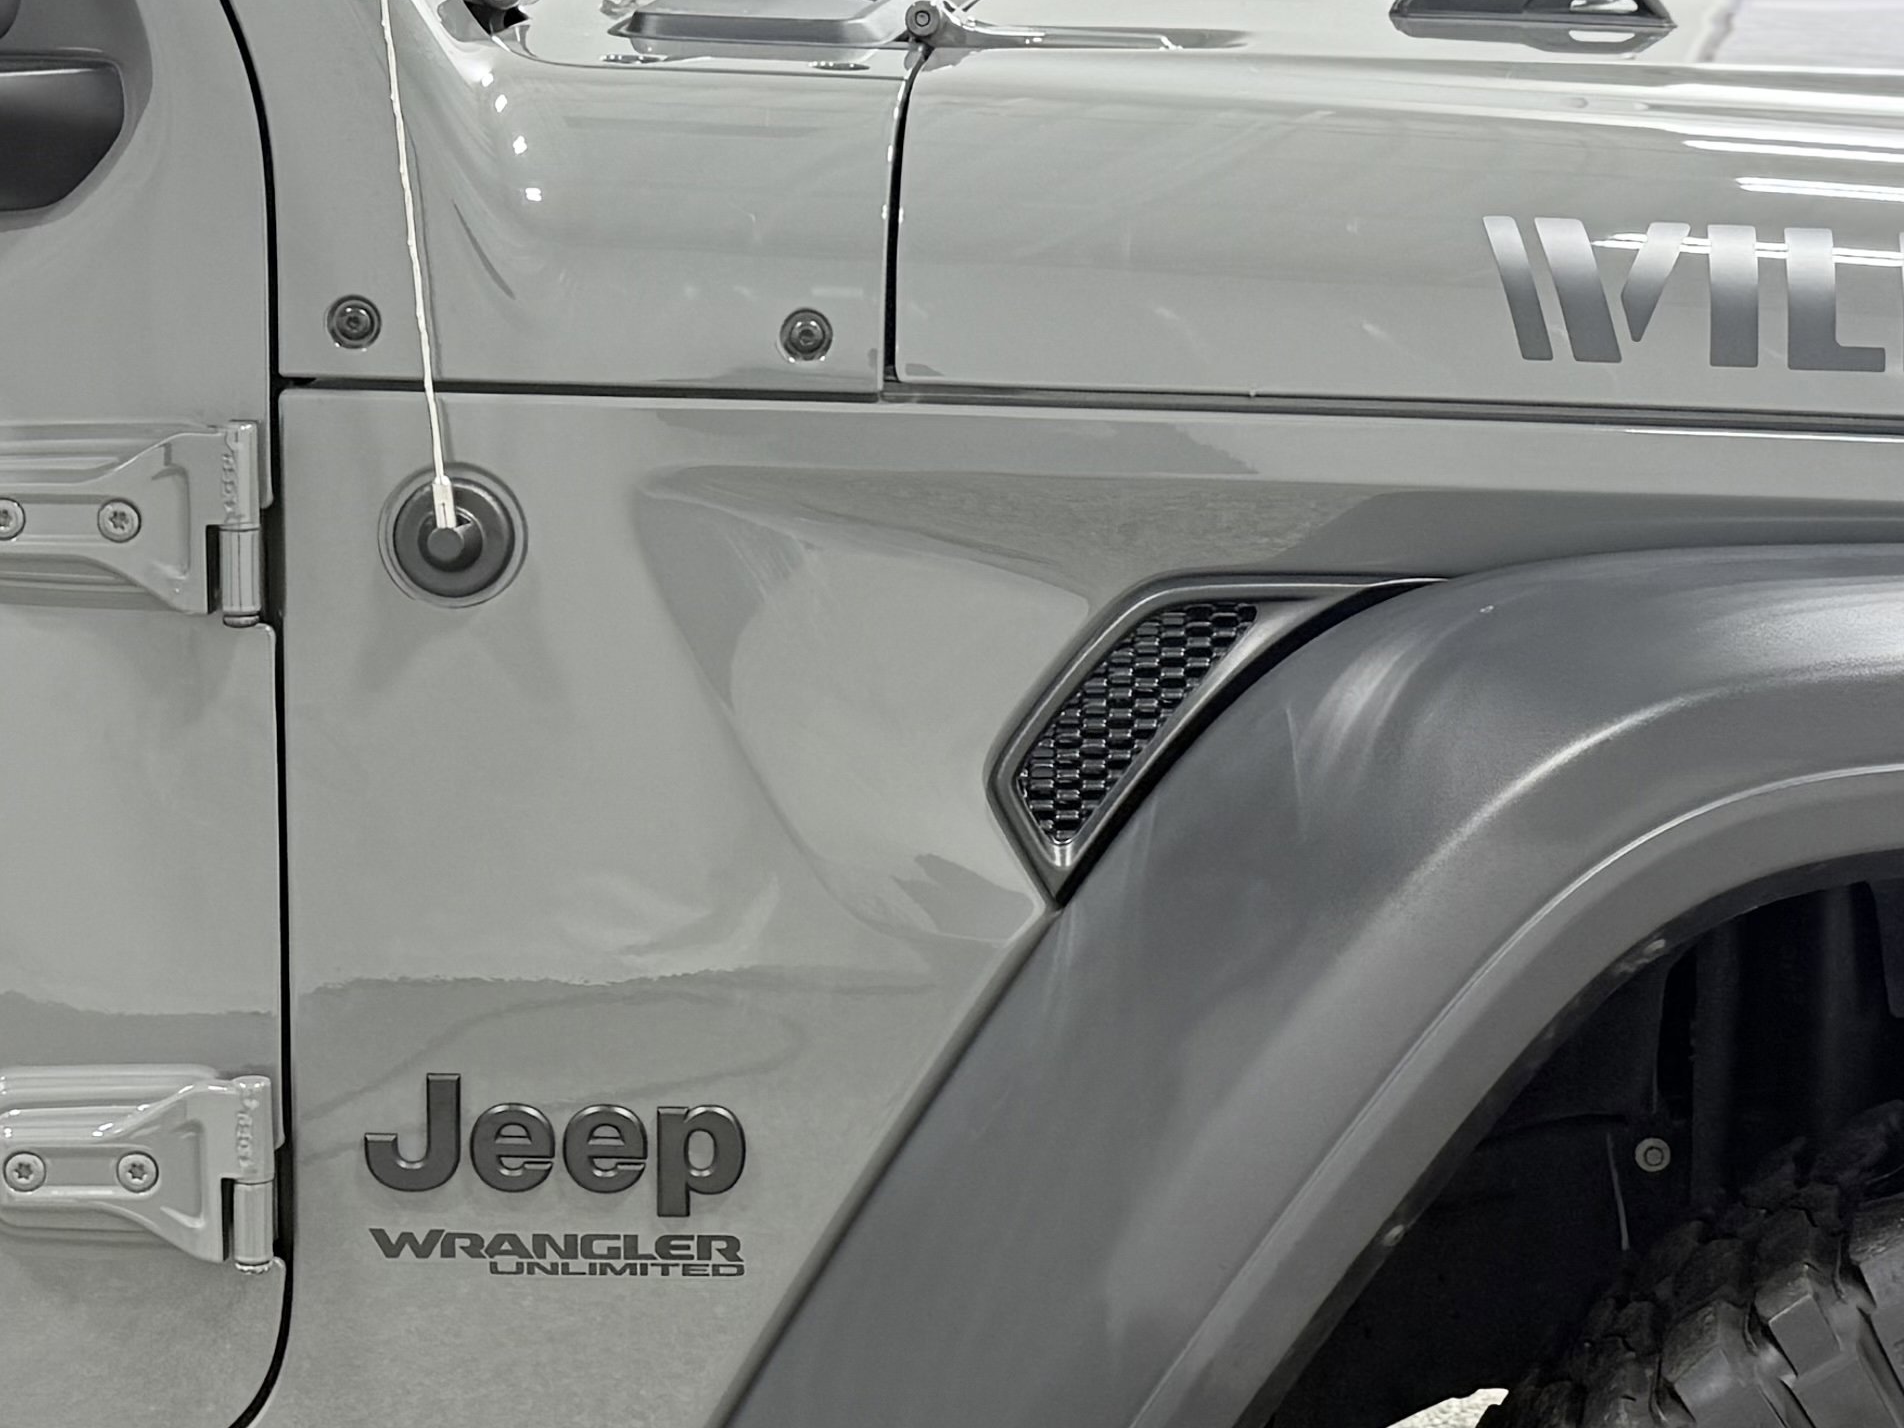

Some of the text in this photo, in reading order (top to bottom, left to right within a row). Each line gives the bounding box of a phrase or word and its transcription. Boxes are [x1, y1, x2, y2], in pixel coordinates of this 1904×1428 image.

[364, 1072, 747, 1218] Jeep
[368, 1227, 745, 1263] WRANGLER
[488, 1261, 746, 1278] UNLIMITED
